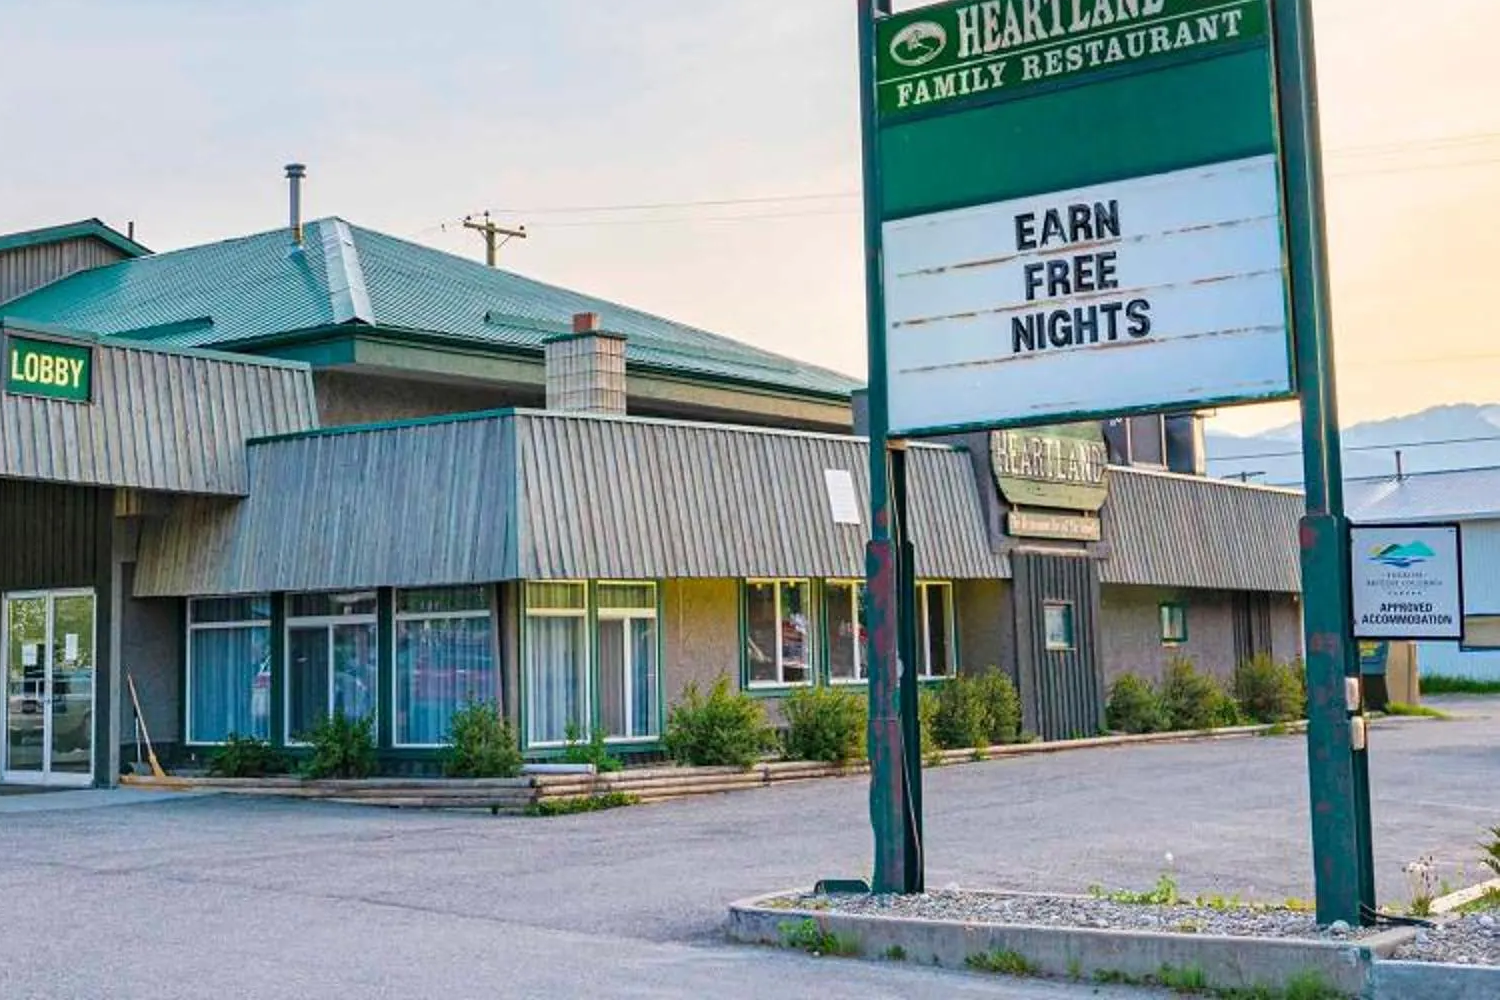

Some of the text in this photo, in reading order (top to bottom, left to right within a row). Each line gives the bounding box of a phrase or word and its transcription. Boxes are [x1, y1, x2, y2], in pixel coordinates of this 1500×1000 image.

[897, 9, 1243, 108] FAMILY RESTAURANT
[1014, 200, 1121, 251] EARN
[1024, 250, 1119, 301] FREE
[1011, 298, 1151, 353] NIGHTS
[11, 348, 84, 389] LOBBY
[991, 430, 1106, 483] HEARTLAND
[1361, 613, 1453, 625] ACCOMMODATION
[1380, 602, 1433, 613] APPROVED
